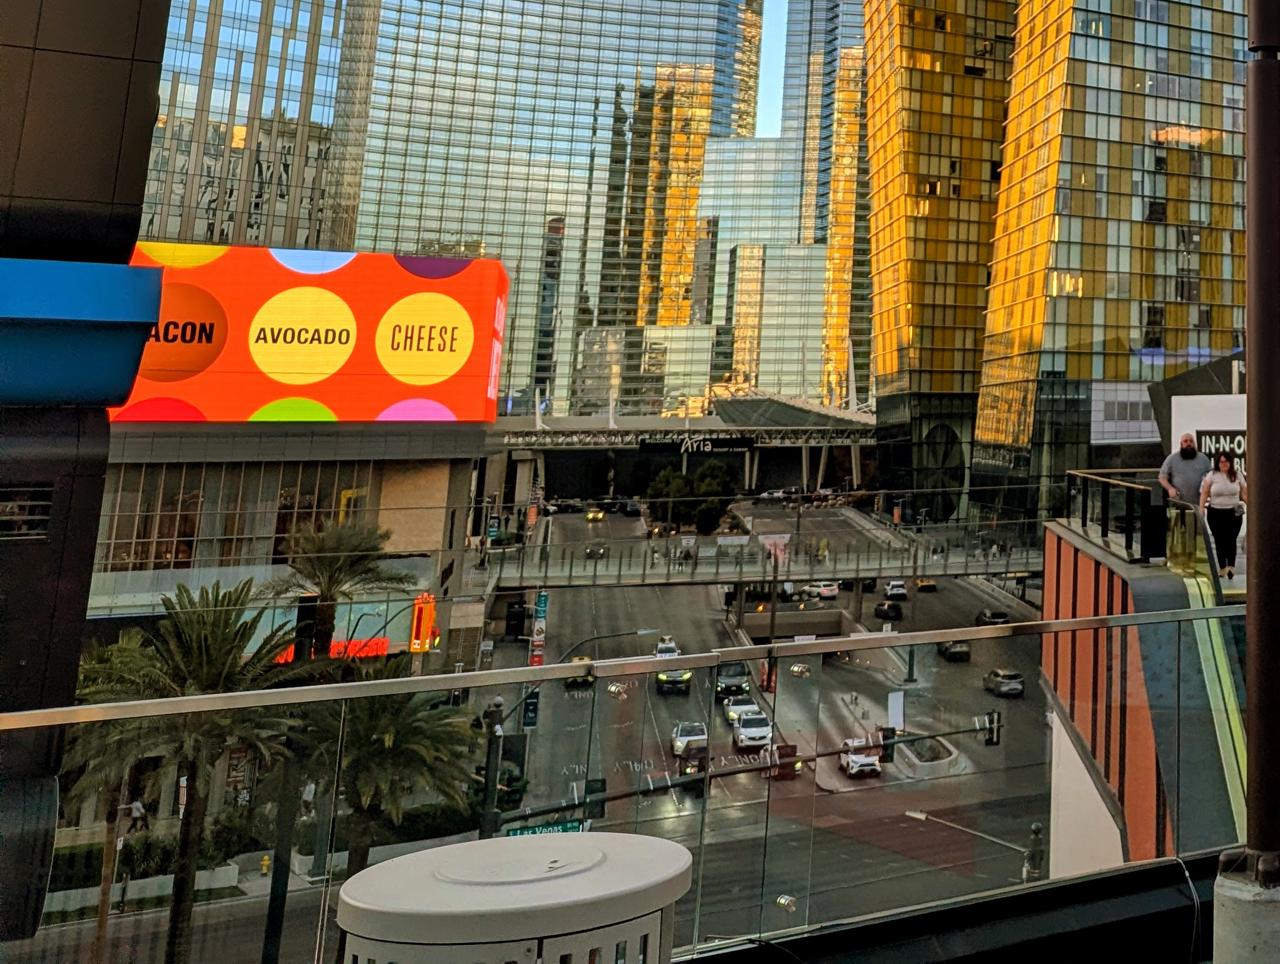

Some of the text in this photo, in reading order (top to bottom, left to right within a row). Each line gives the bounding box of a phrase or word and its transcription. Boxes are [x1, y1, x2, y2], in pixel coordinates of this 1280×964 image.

[149, 321, 215, 344] ACON
[254, 327, 351, 346] AVOCADO
[390, 324, 459, 353] CHEESE
[680, 436, 712, 453] Aria
[1201, 434, 1247, 455] IN-N-O
[535, 825, 563, 834] Vegas
